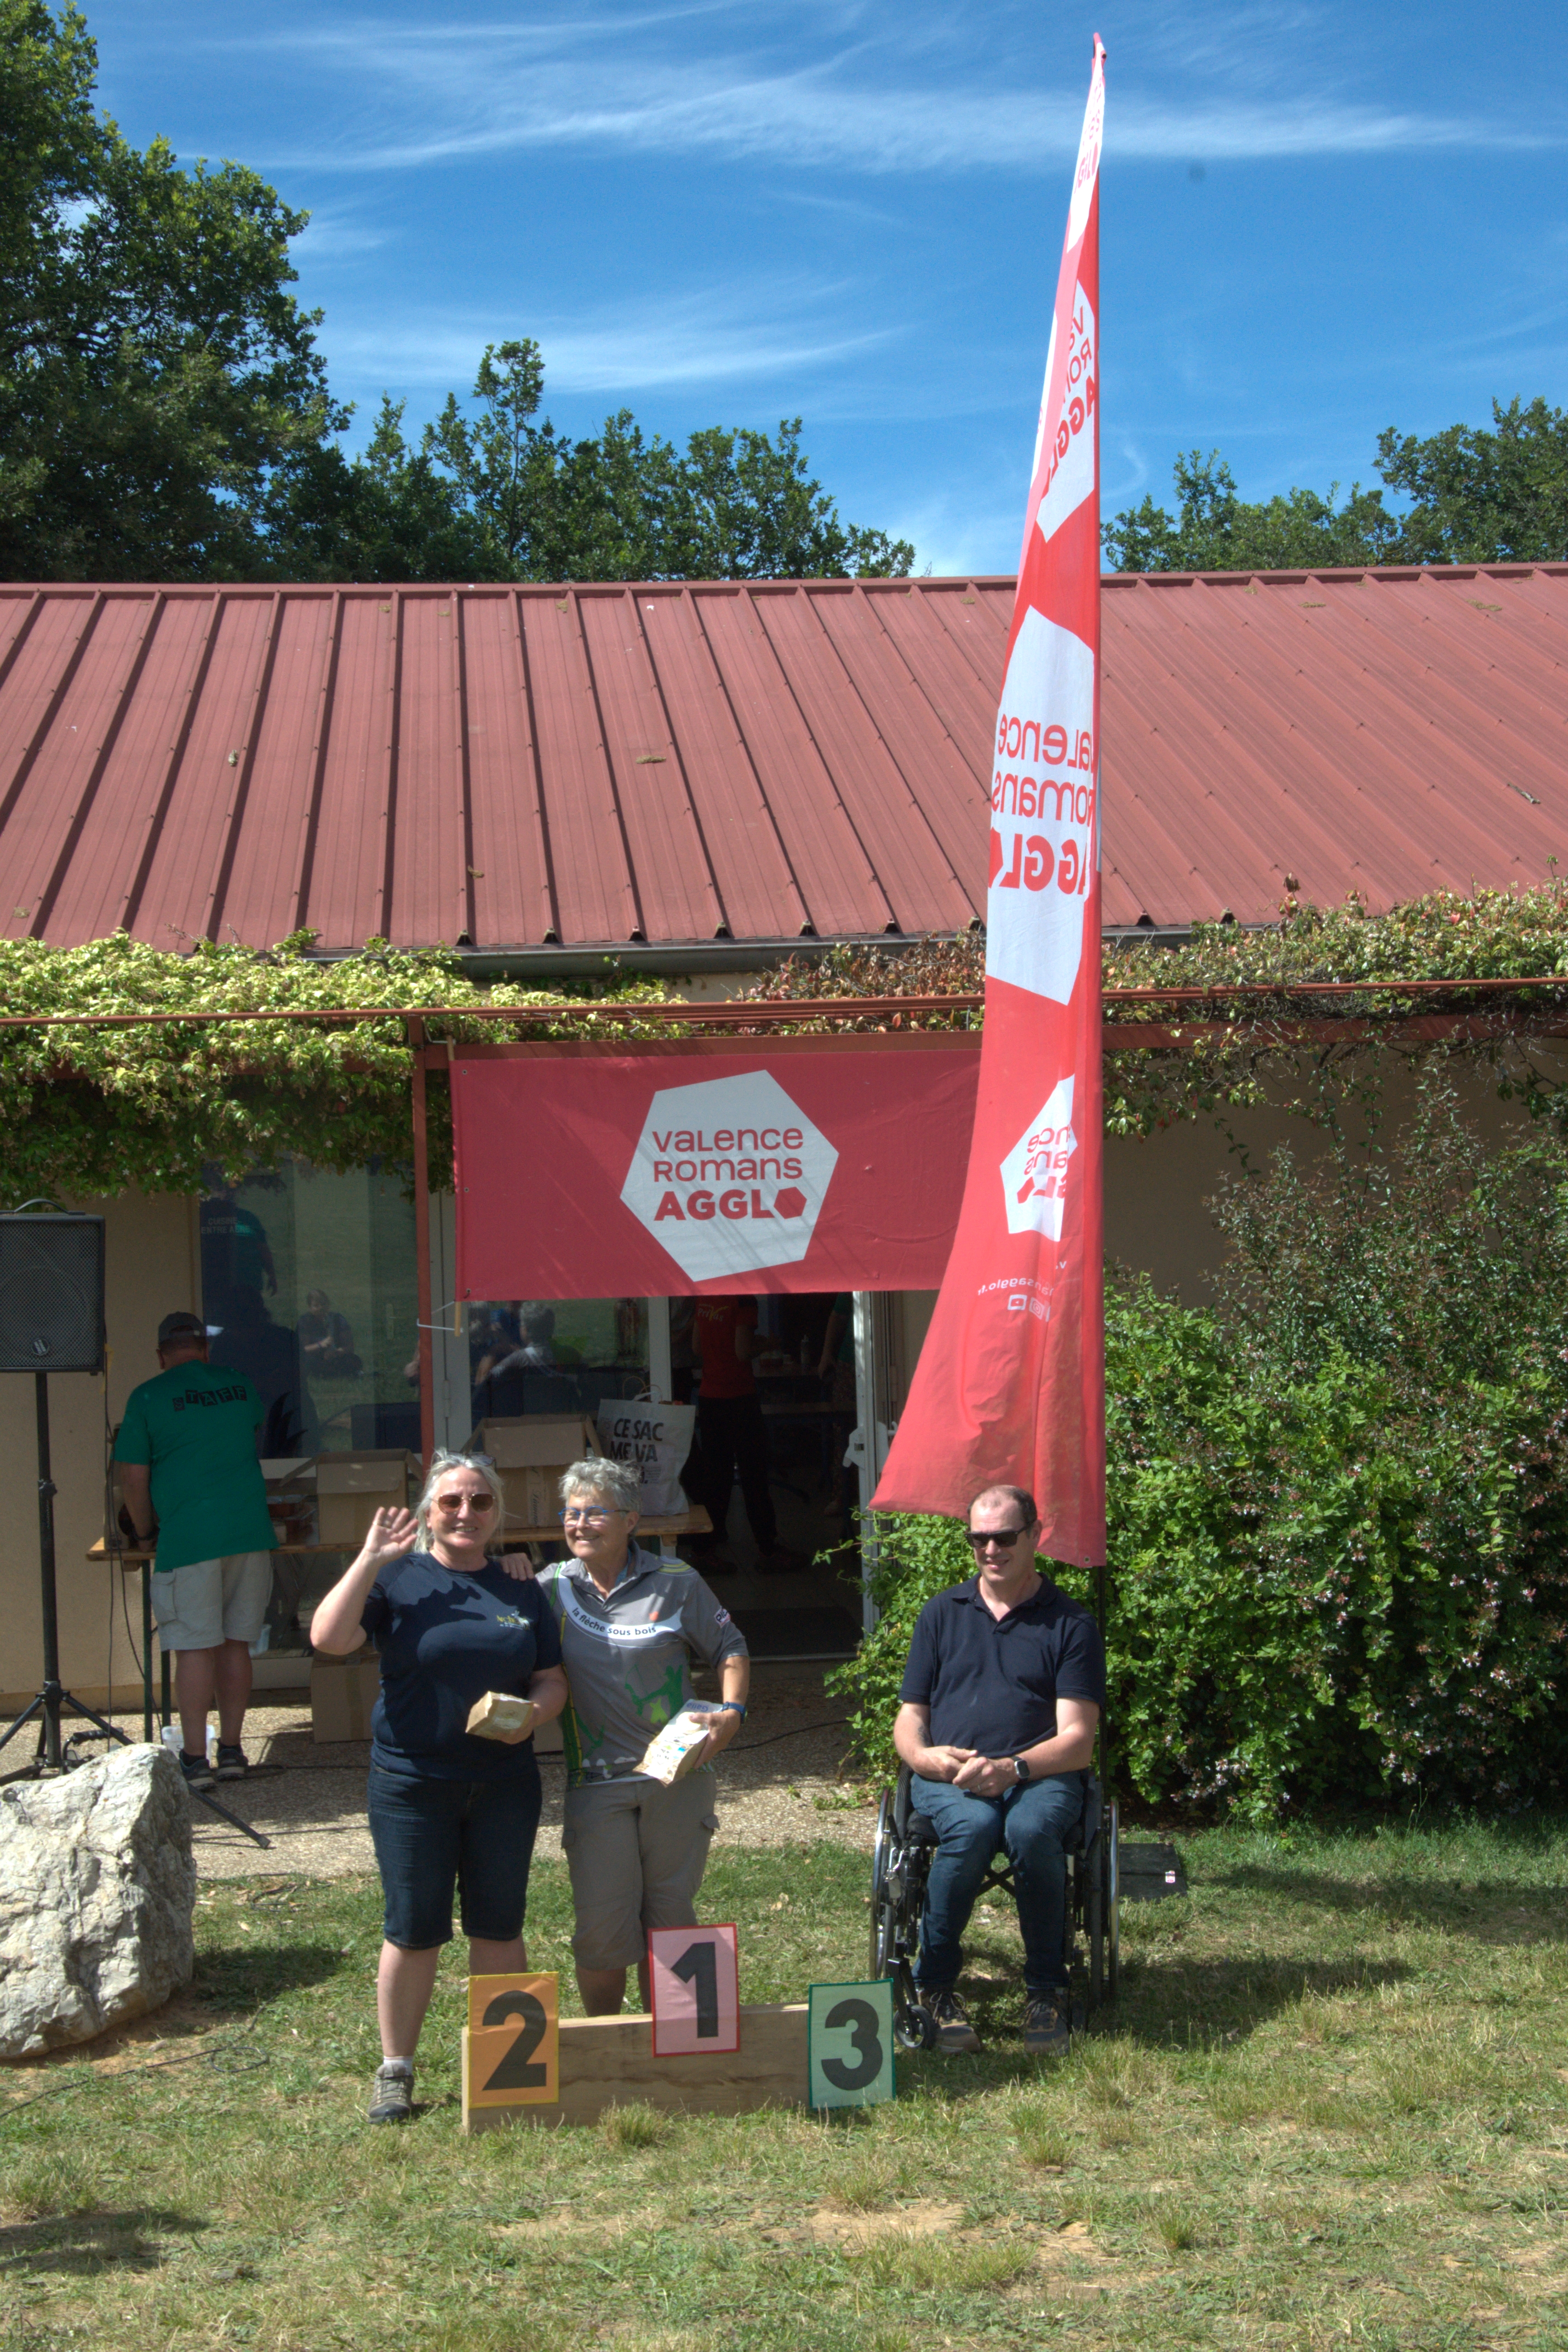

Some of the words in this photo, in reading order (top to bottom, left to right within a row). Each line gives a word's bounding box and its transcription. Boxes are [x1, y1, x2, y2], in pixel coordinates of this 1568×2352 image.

[654, 1158, 803, 1182] Romans
[173, 1386, 247, 1412] STAFF
[614, 1418, 631, 1438] CE
[632, 1420, 664, 1441] SAC
[610, 1440, 631, 1460] ME
[635, 1444, 658, 1462] VA
[572, 1607, 580, 1617] la
[579, 1615, 606, 1632] flèche
[607, 1627, 631, 1635] sous
[634, 1626, 656, 1635] bois
[671, 1941, 719, 2039] 1
[482, 1990, 547, 2091] 2
[821, 1998, 883, 2091] 3
